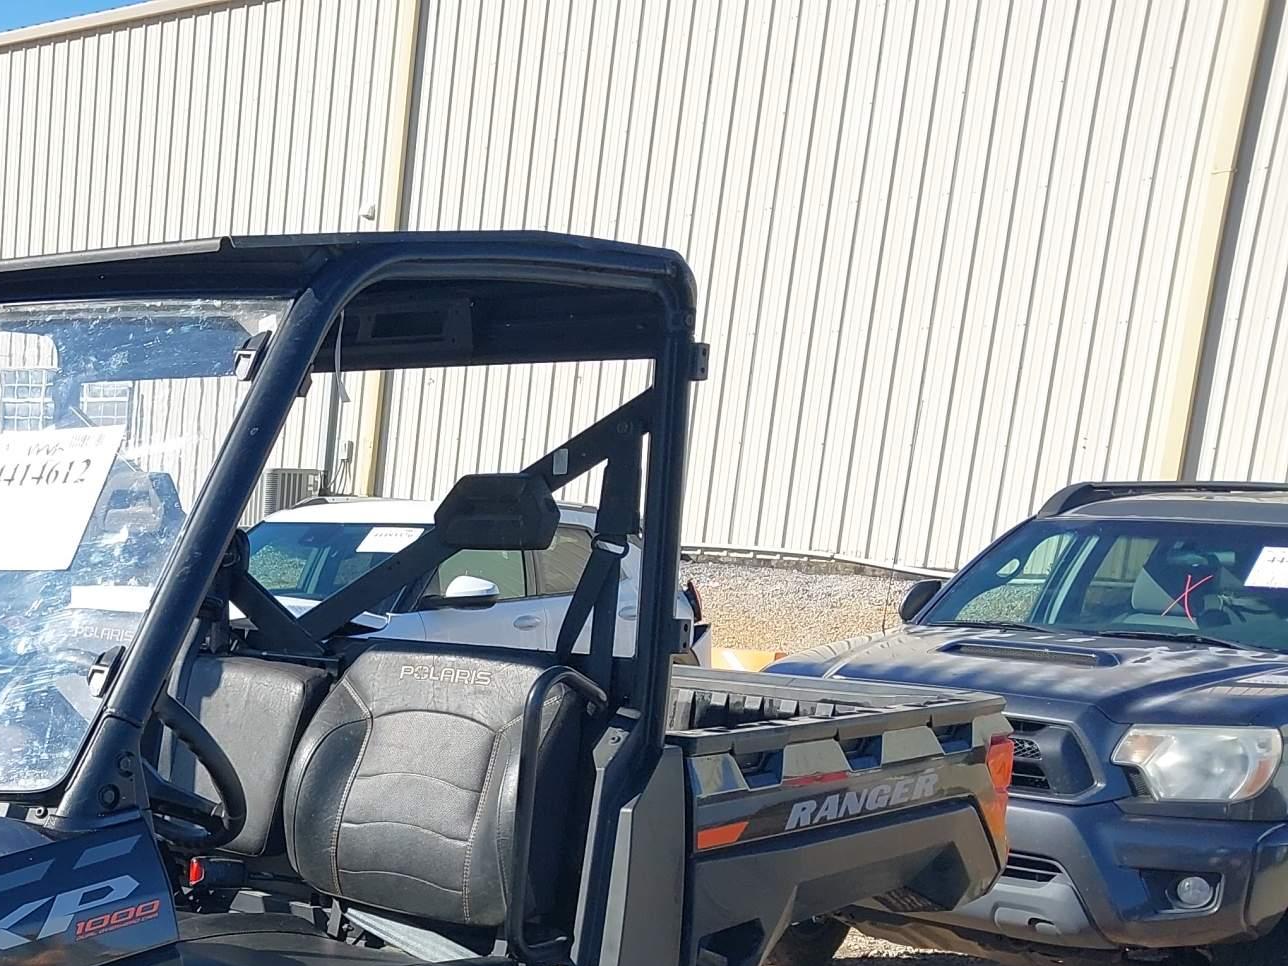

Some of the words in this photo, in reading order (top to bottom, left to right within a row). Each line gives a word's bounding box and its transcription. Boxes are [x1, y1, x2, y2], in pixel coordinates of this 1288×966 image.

[399, 665, 492, 685] POLARIS
[785, 769, 938, 830] RANGER
[76, 899, 160, 936] 1000
